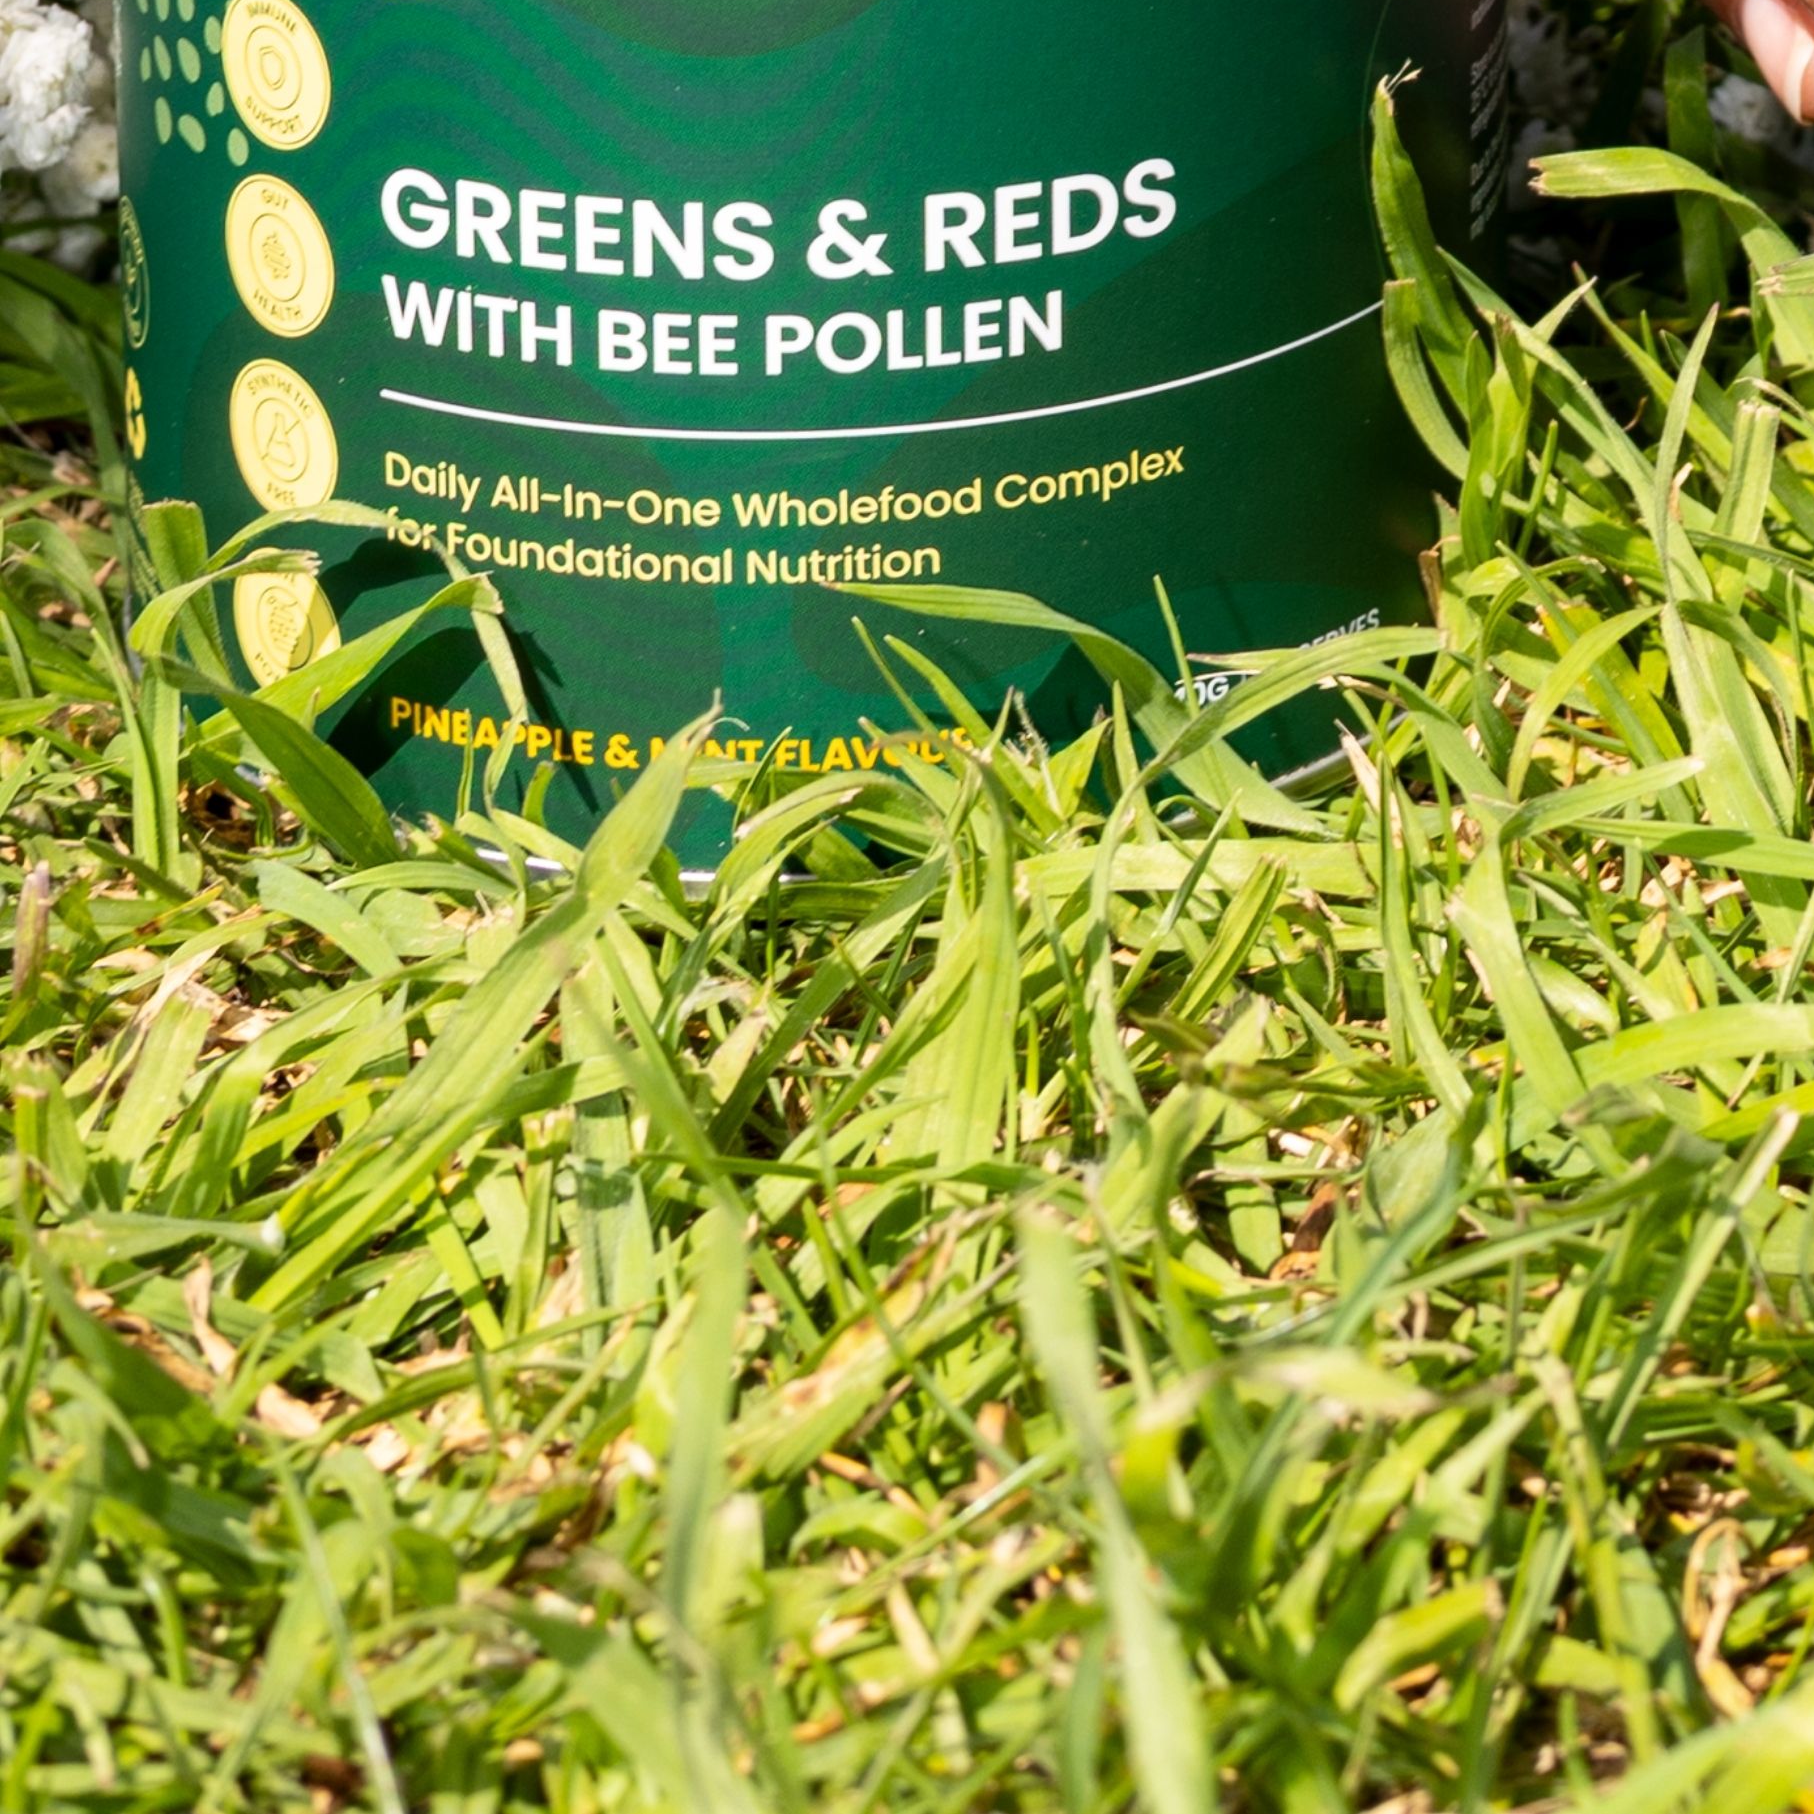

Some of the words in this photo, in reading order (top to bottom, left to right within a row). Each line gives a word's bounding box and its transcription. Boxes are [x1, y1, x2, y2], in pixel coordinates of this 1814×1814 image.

[260, 188, 290, 211] GUT
[380, 168, 776, 282] GREENS
[806, 198, 895, 281] &
[924, 158, 1177, 272] REDS
[380, 274, 573, 368] WITH
[598, 309, 739, 376] BEE
[764, 289, 1064, 377] POLLEN
[384, 451, 482, 513] Daily
[490, 474, 723, 528] All-In-One
[731, 478, 983, 528] Wholefood
[993, 445, 1185, 502] Complex
[386, 506, 437, 551] for
[446, 521, 733, 584] Foundational
[745, 543, 941, 584] Nutrition
[603, 733, 640, 769] &
